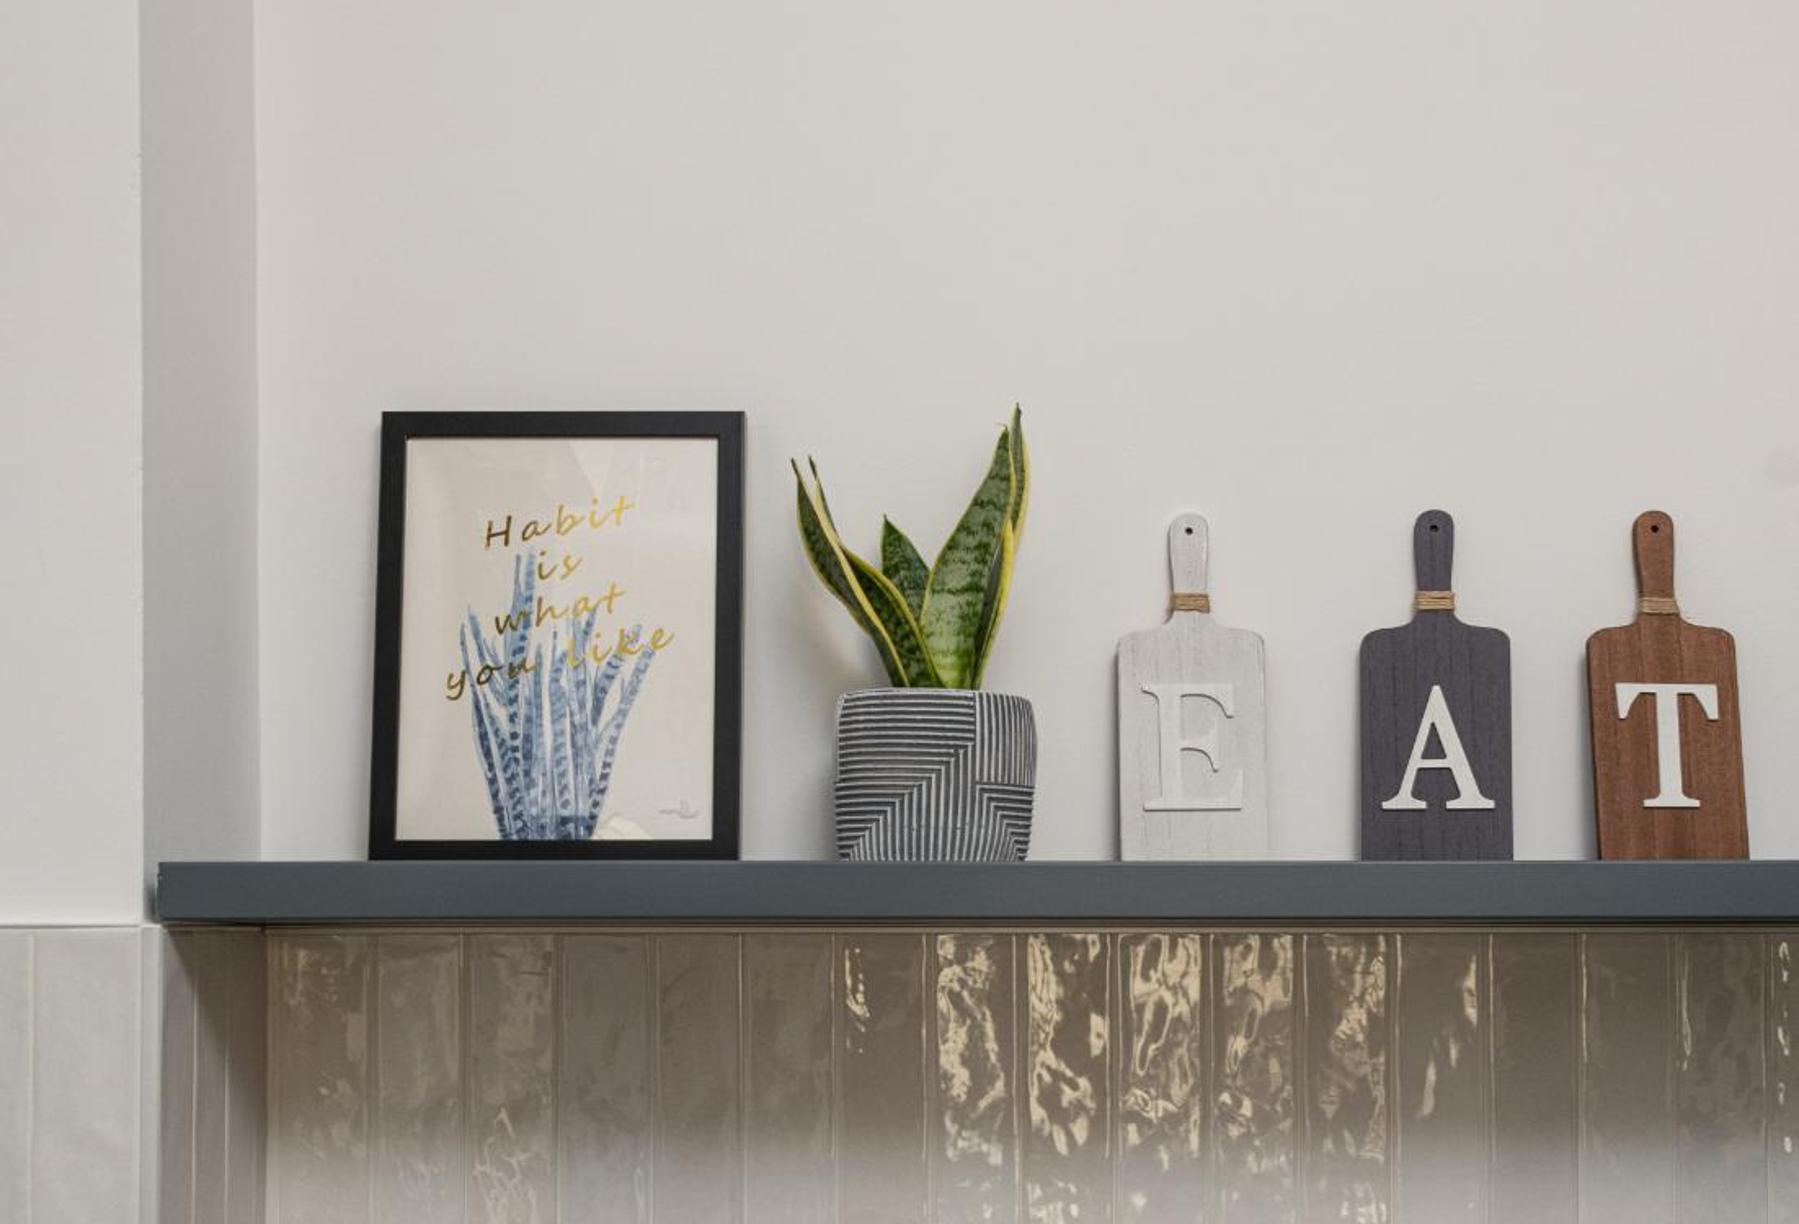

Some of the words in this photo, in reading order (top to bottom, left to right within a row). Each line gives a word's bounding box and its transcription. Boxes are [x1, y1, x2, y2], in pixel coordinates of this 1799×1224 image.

[485, 495, 636, 550] Habit
[537, 550, 582, 581] is
[495, 583, 626, 635] what
[446, 657, 535, 701] you
[567, 628, 674, 669] like
[1381, 684, 1496, 810] A
[1615, 682, 1719, 808] T
